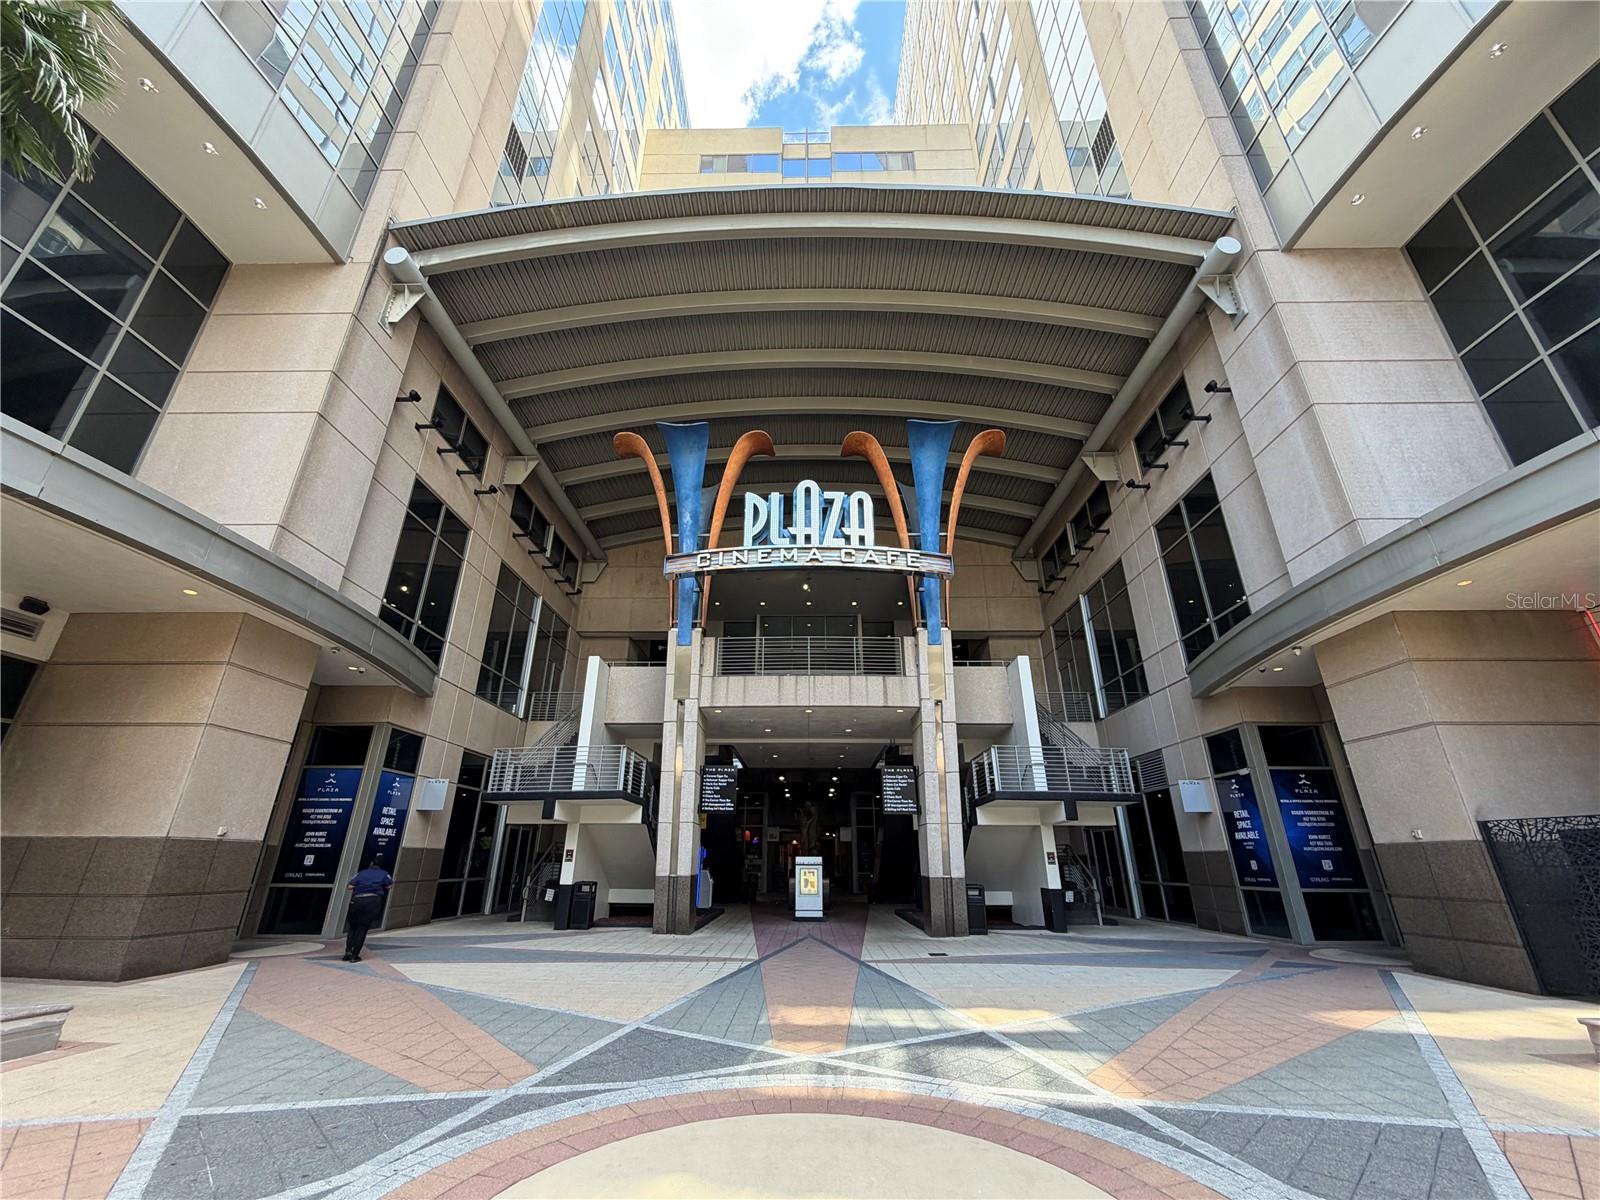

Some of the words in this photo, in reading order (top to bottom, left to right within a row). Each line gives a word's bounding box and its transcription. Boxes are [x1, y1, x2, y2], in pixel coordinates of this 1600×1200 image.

[745, 480, 875, 547] PLAZA
[696, 547, 824, 568] CINEMA
[840, 548, 922, 568] CAFE
[382, 806, 397, 815] RETAIL
[1233, 810, 1250, 818] RETAIL
[380, 816, 395, 826] SPACE
[1236, 820, 1252, 829] SPACE
[373, 827, 397, 837] AVAILABLE
[1235, 831, 1260, 839] AVAILABLE
